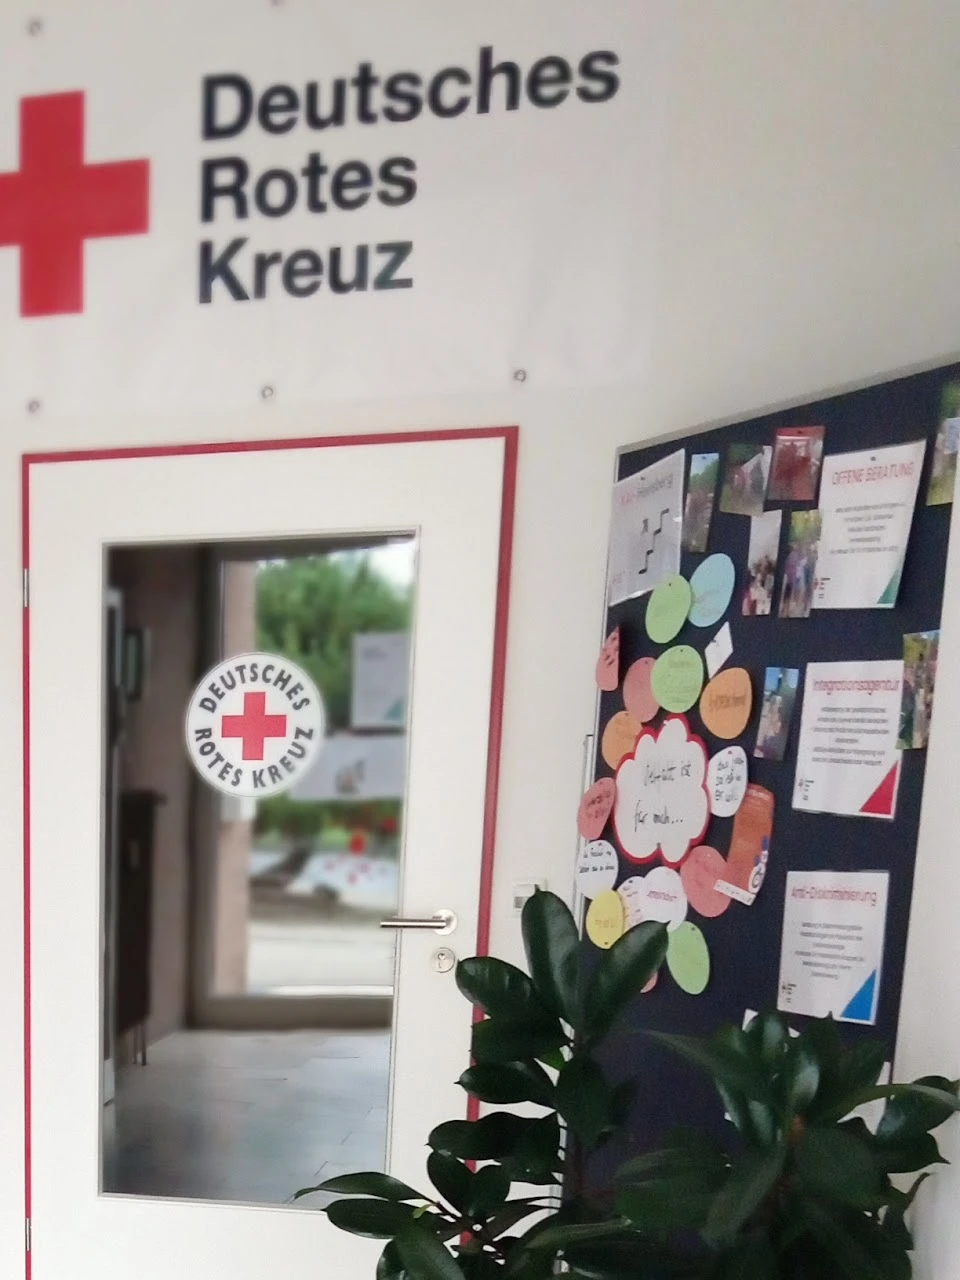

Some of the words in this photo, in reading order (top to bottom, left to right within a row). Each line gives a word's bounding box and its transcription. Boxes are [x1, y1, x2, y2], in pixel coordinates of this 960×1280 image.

[200, 45, 621, 141] Deutsches
[200, 152, 418, 223] Rotes
[198, 236, 414, 304] Kreuz
[198, 662, 311, 714] DEUTSCHES
[194, 727, 243, 787] ROTES
[252, 726, 314, 789] KREUZ
